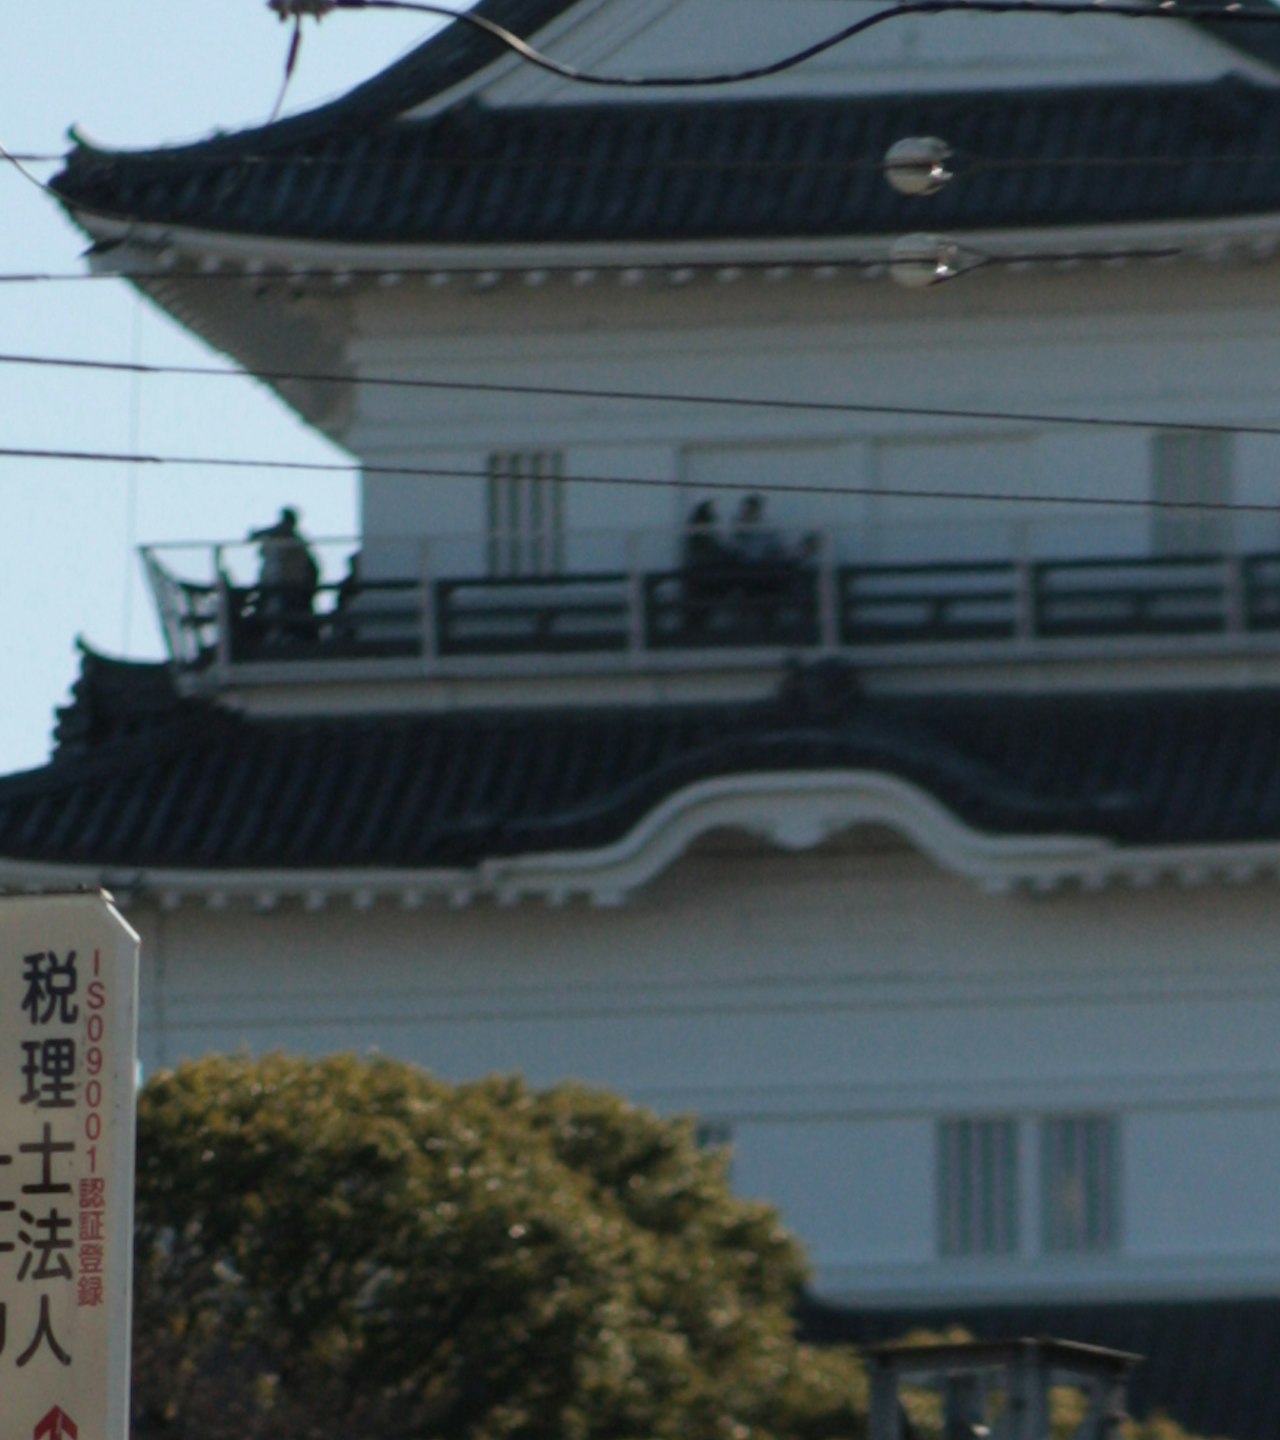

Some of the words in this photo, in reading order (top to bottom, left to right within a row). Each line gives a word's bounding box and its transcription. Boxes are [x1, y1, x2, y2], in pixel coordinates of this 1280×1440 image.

[15, 949, 81, 1368] 税理士法人
